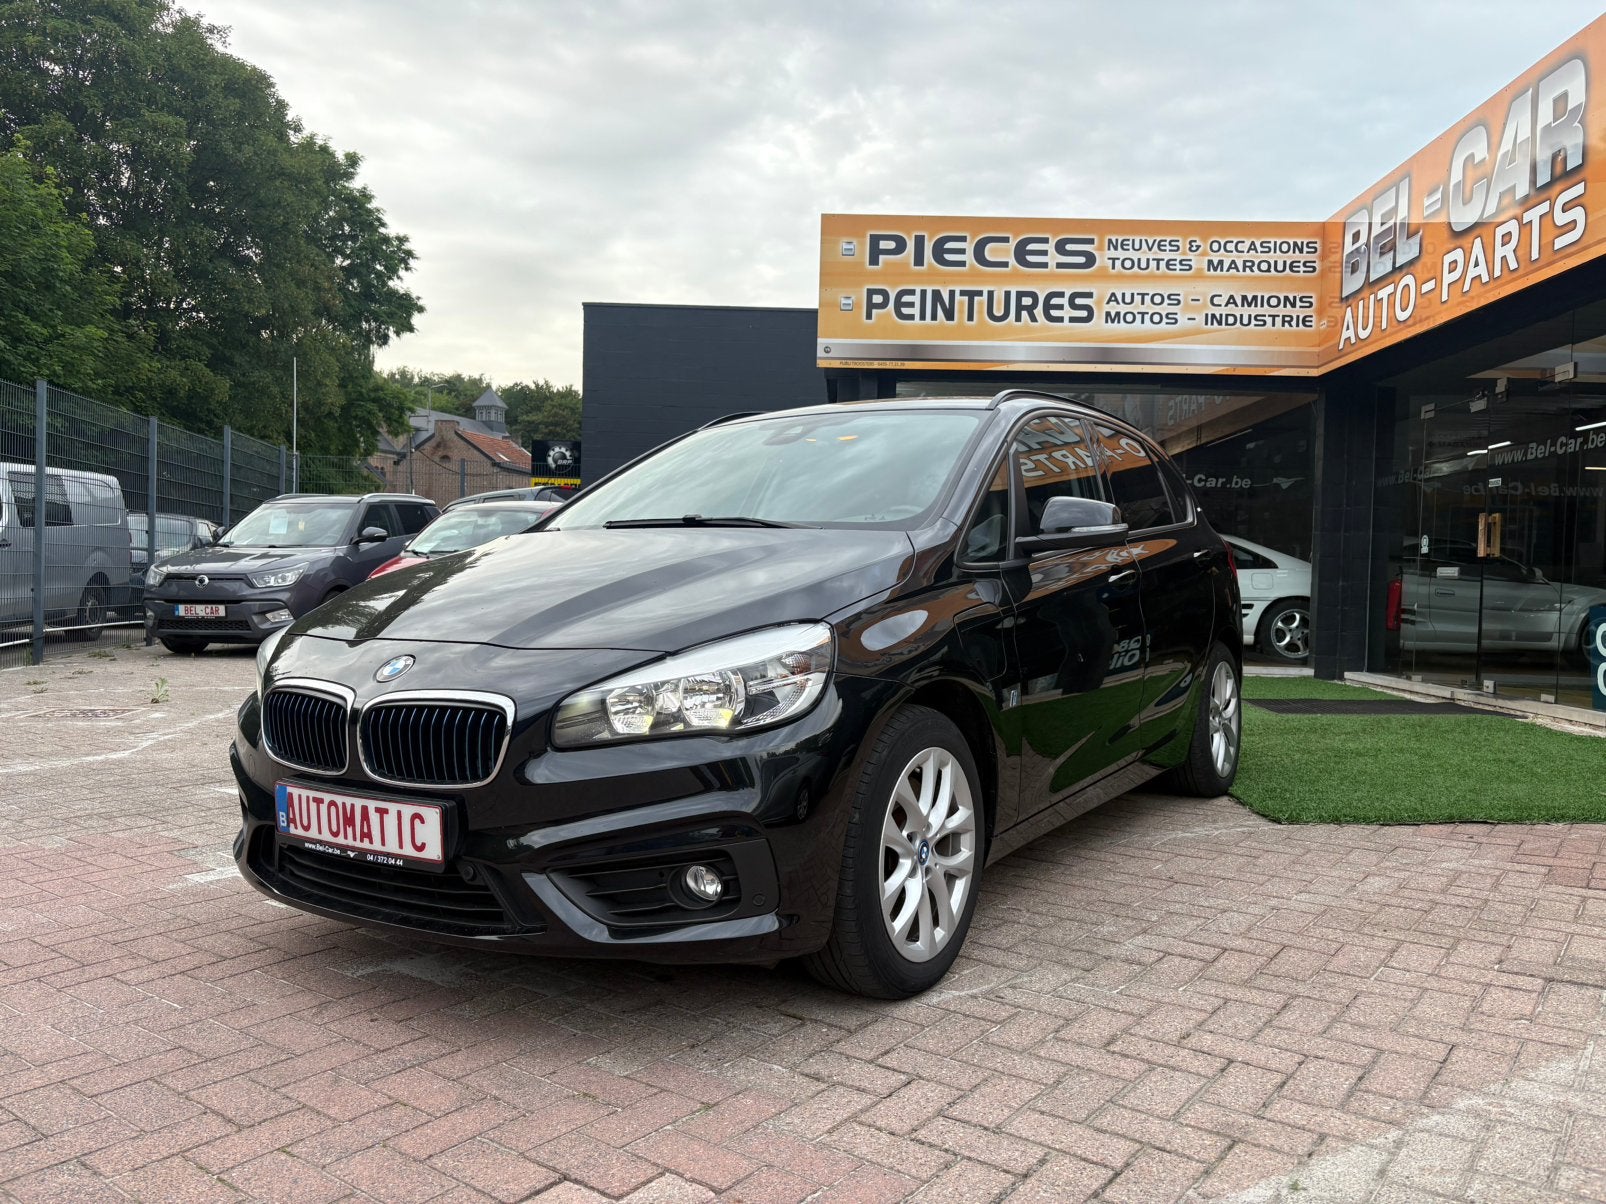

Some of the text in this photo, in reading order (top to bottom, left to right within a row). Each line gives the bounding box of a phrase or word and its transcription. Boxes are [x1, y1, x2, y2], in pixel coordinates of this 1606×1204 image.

[1341, 58, 1587, 300] BEL-CAR
[868, 233, 1097, 270] PIECES
[1107, 238, 1318, 255] NEUVES & OCCASIONS
[1107, 257, 1317, 274] TOUTES MARQUES
[1338, 180, 1587, 351] AUTO-PARTS
[865, 287, 1095, 324] PEINTURES
[1105, 292, 1182, 306] AUTOS
[1209, 294, 1314, 309] CAMIONS
[1104, 311, 1179, 325] MOTOS
[1204, 313, 1314, 328] INDUSTRIE
[1495, 430, 1606, 466] www.Bel-Car.be
[1183, 474, 1252, 488] -Car.be
[278, 811, 287, 827] B
[286, 791, 427, 853] AUTOMATIC
[304, 842, 341, 855] www.Bel-Car.be
[377, 855, 388, 864] 372
[395, 858, 403, 866] 44
